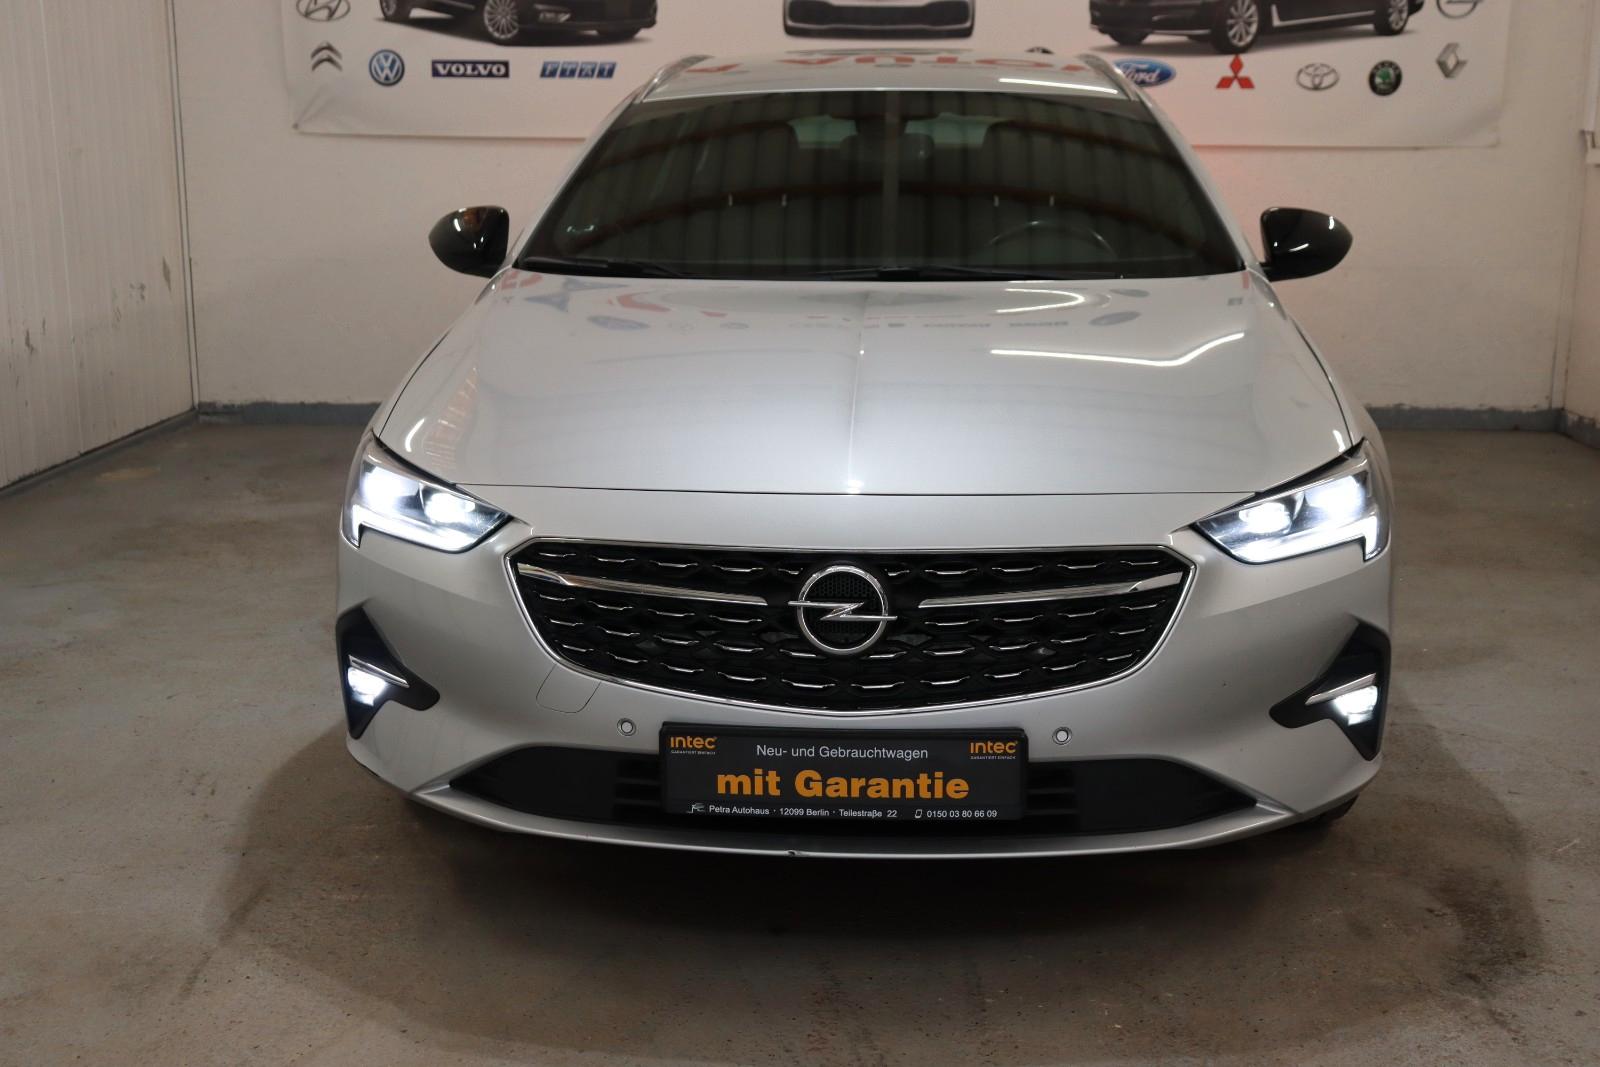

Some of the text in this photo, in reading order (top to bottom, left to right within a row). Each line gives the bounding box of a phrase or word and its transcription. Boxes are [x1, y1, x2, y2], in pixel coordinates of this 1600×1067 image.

[434, 62, 506, 77] VOLVO
[670, 735, 717, 749] intec
[969, 740, 1017, 754] intec
[756, 744, 929, 761] Neu- und Gebrauchtwagen
[717, 768, 970, 800] mit Garantie
[708, 804, 898, 818] Petra Autohaus 12099 Berlin Teilestraße 22
[926, 809, 947, 818] 0150
[949, 809, 960, 818] 03
[961, 809, 972, 818] 80
[974, 809, 985, 818] 66
